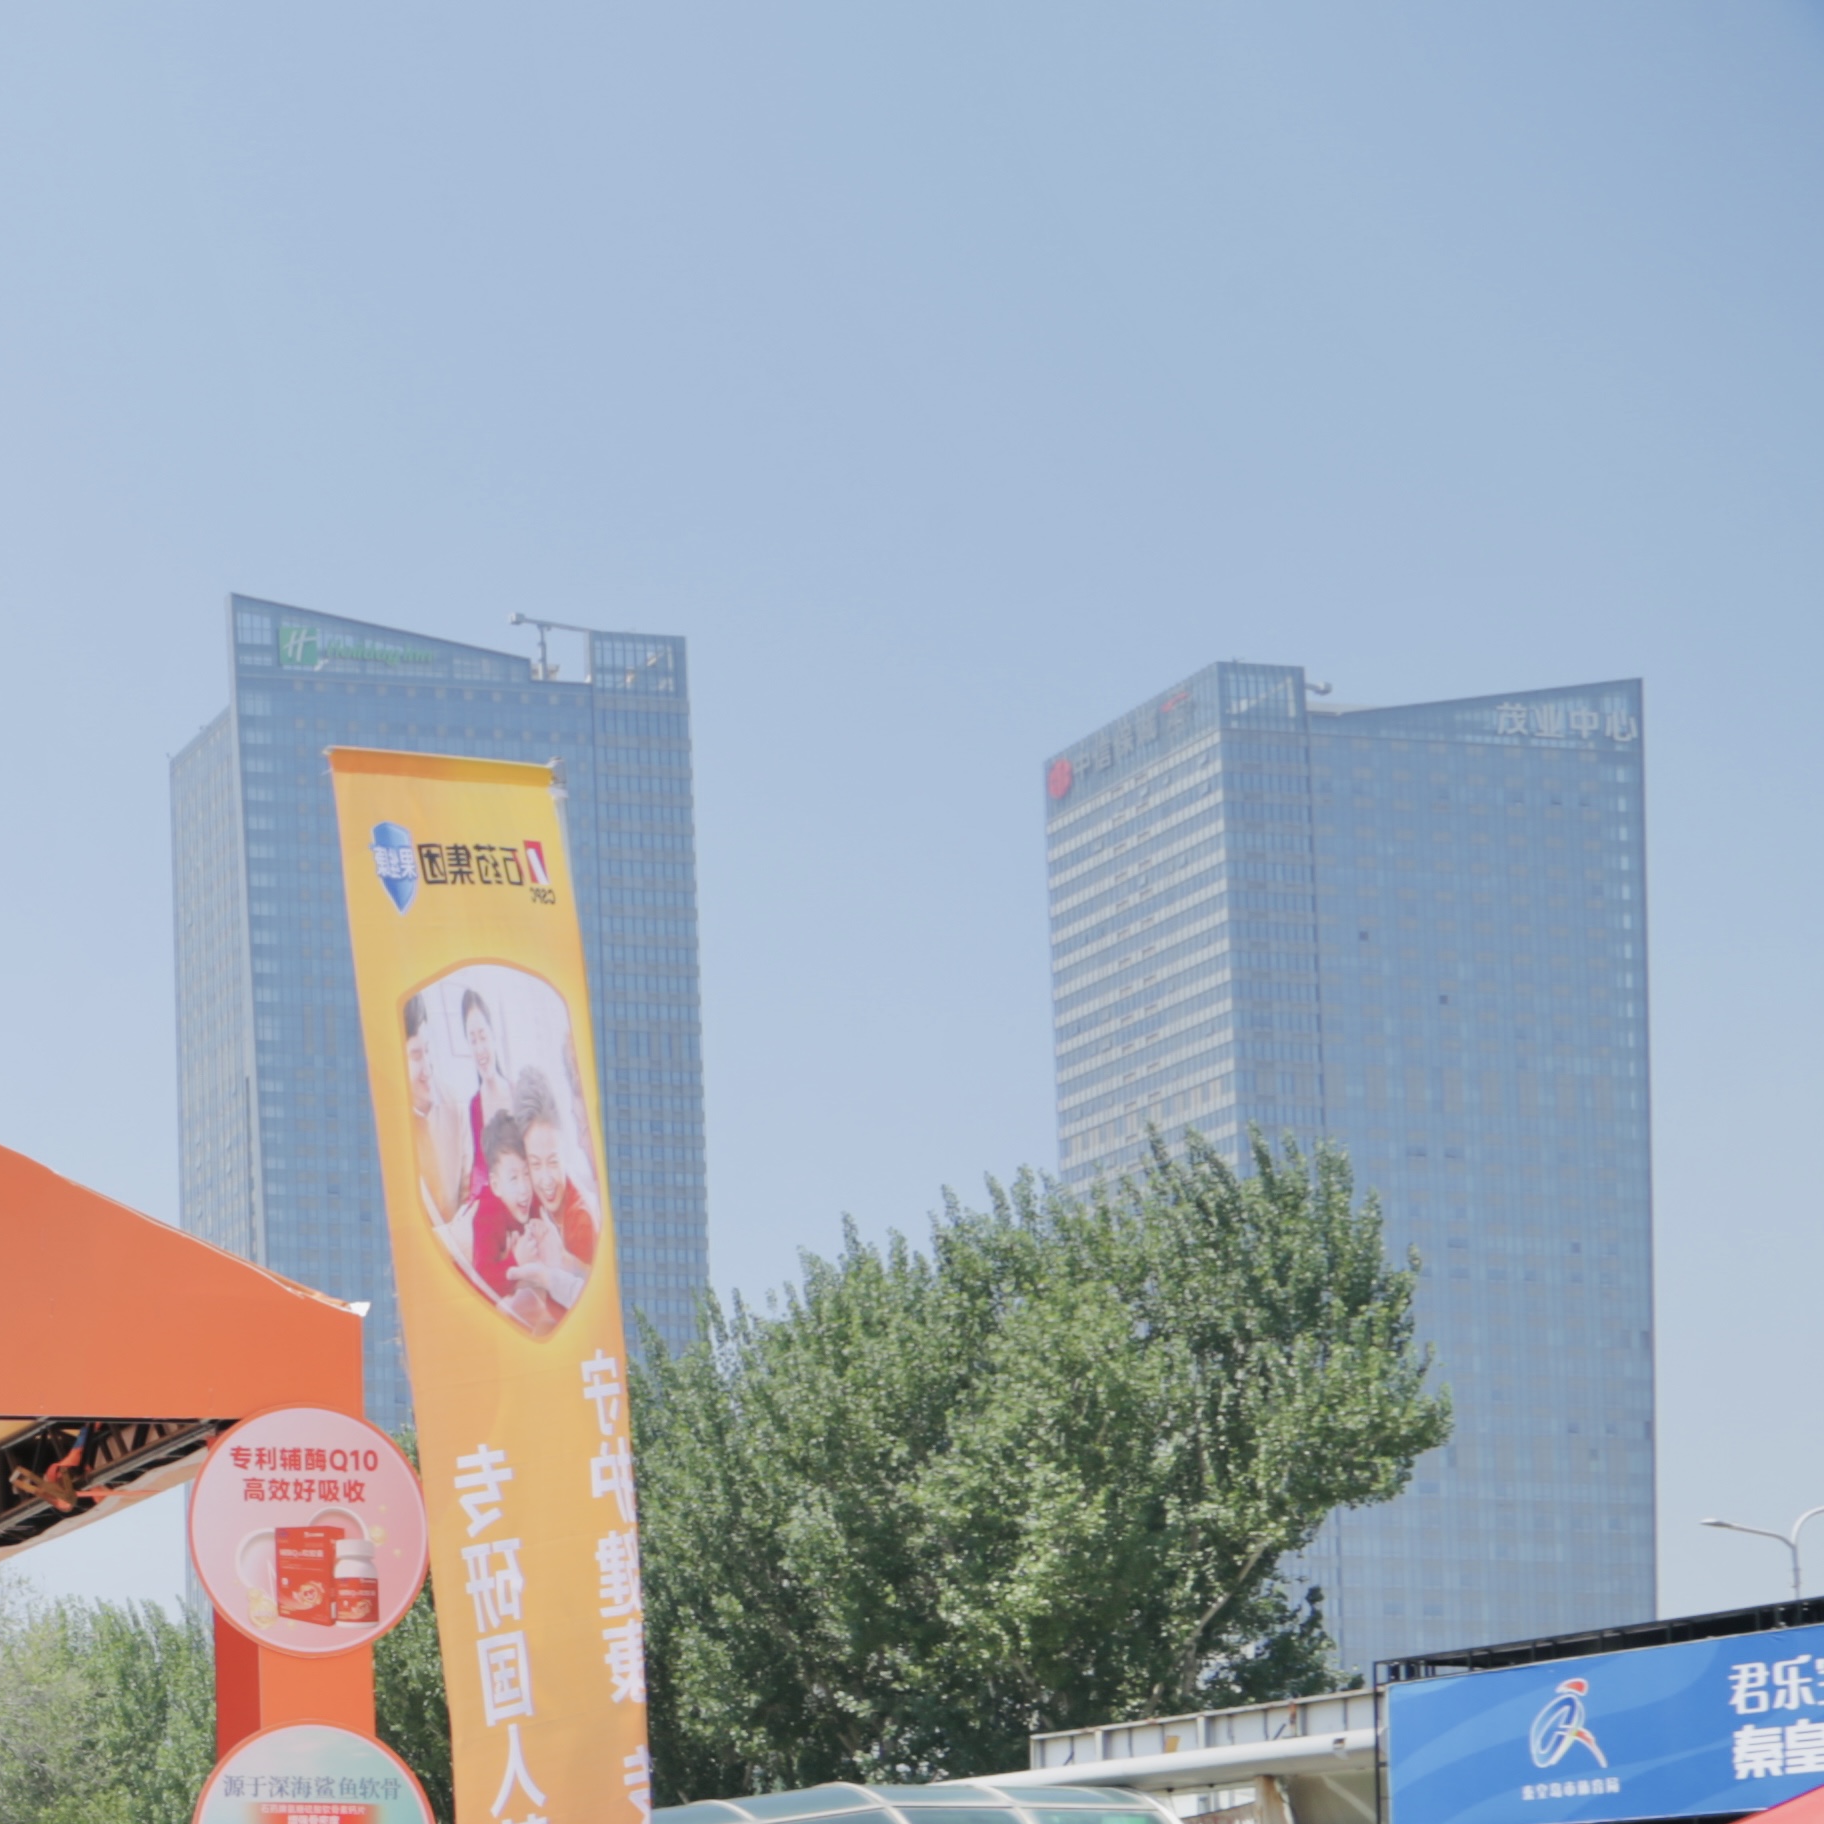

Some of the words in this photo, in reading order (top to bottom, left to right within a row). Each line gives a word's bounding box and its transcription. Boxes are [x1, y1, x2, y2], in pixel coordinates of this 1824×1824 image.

[1496, 703, 1637, 741] 茂业中心
[230, 1446, 379, 1472] 专利辅酶Q10
[242, 1477, 366, 1503] 高效好吸收
[223, 1775, 402, 1800] 源于深海鲨鱼软骨
